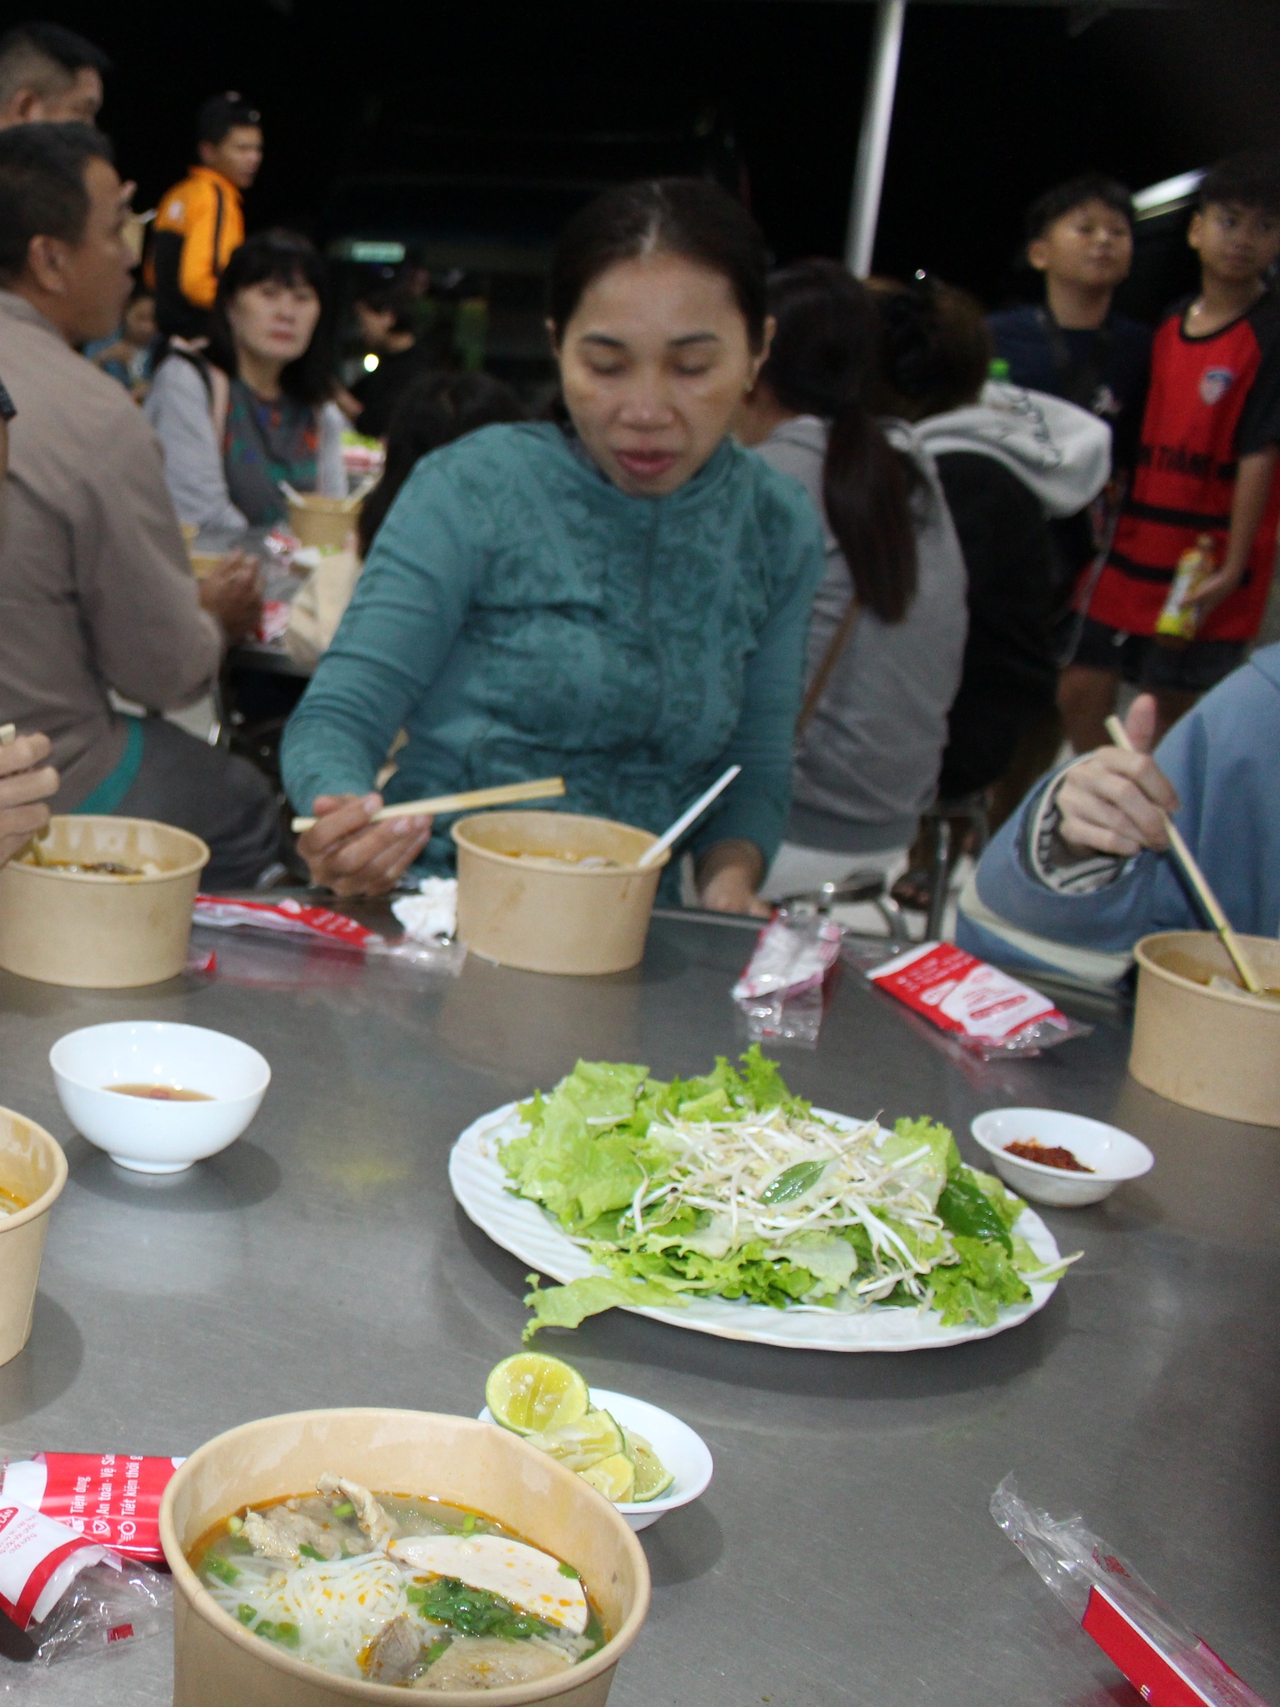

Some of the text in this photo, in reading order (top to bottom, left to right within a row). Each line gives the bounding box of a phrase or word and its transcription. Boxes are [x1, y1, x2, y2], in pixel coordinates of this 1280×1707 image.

[99, 1467, 117, 1478] Vệ
[70, 1495, 88, 1514] Tiện
[95, 1503, 110, 1516] An
[120, 1499, 137, 1516] Tiết
